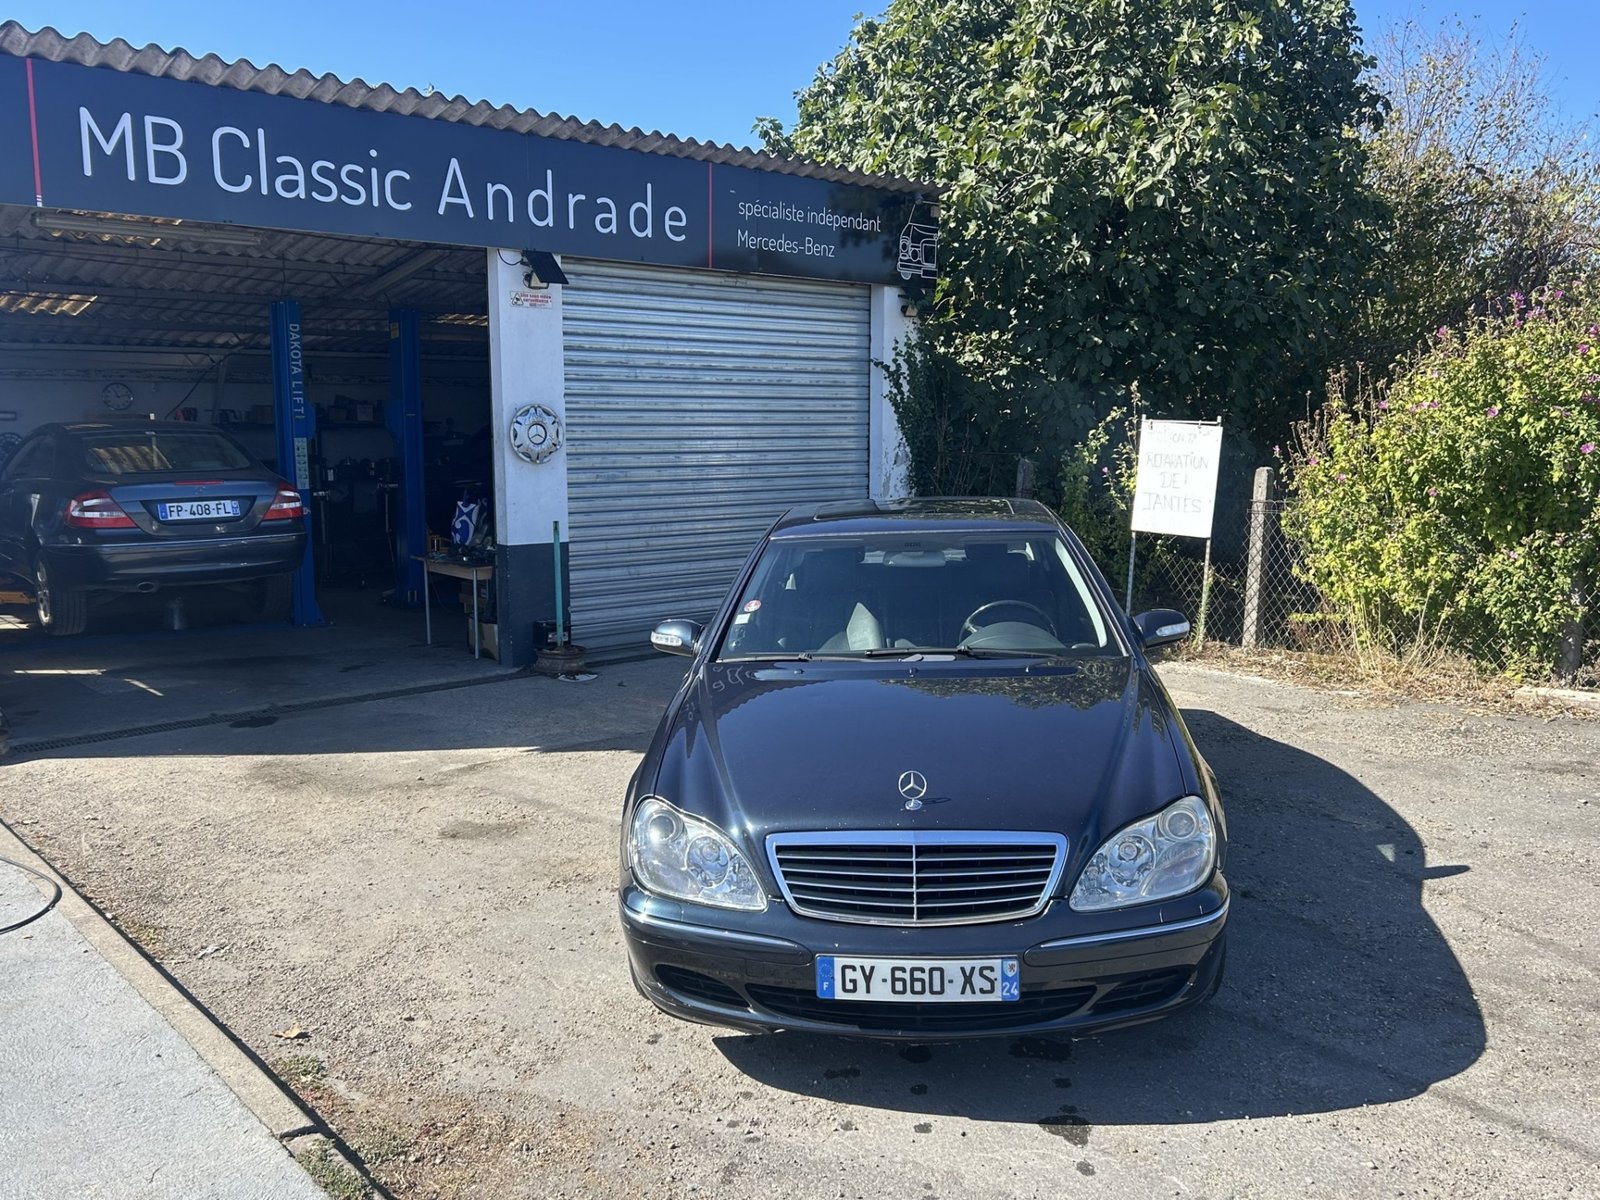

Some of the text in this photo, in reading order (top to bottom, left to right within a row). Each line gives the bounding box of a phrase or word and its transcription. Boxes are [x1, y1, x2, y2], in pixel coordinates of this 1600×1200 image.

[79, 106, 686, 242] MB Classic Andrade
[738, 200, 881, 232] spécialiste indépendant
[737, 229, 835, 258] Mercedes-Benz
[289, 323, 305, 414] DAKOTA LIFT
[168, 502, 231, 518] FP-408-FL
[822, 981, 829, 991] F
[840, 964, 996, 996] GY-660-XS
[1002, 982, 1018, 996] 24
